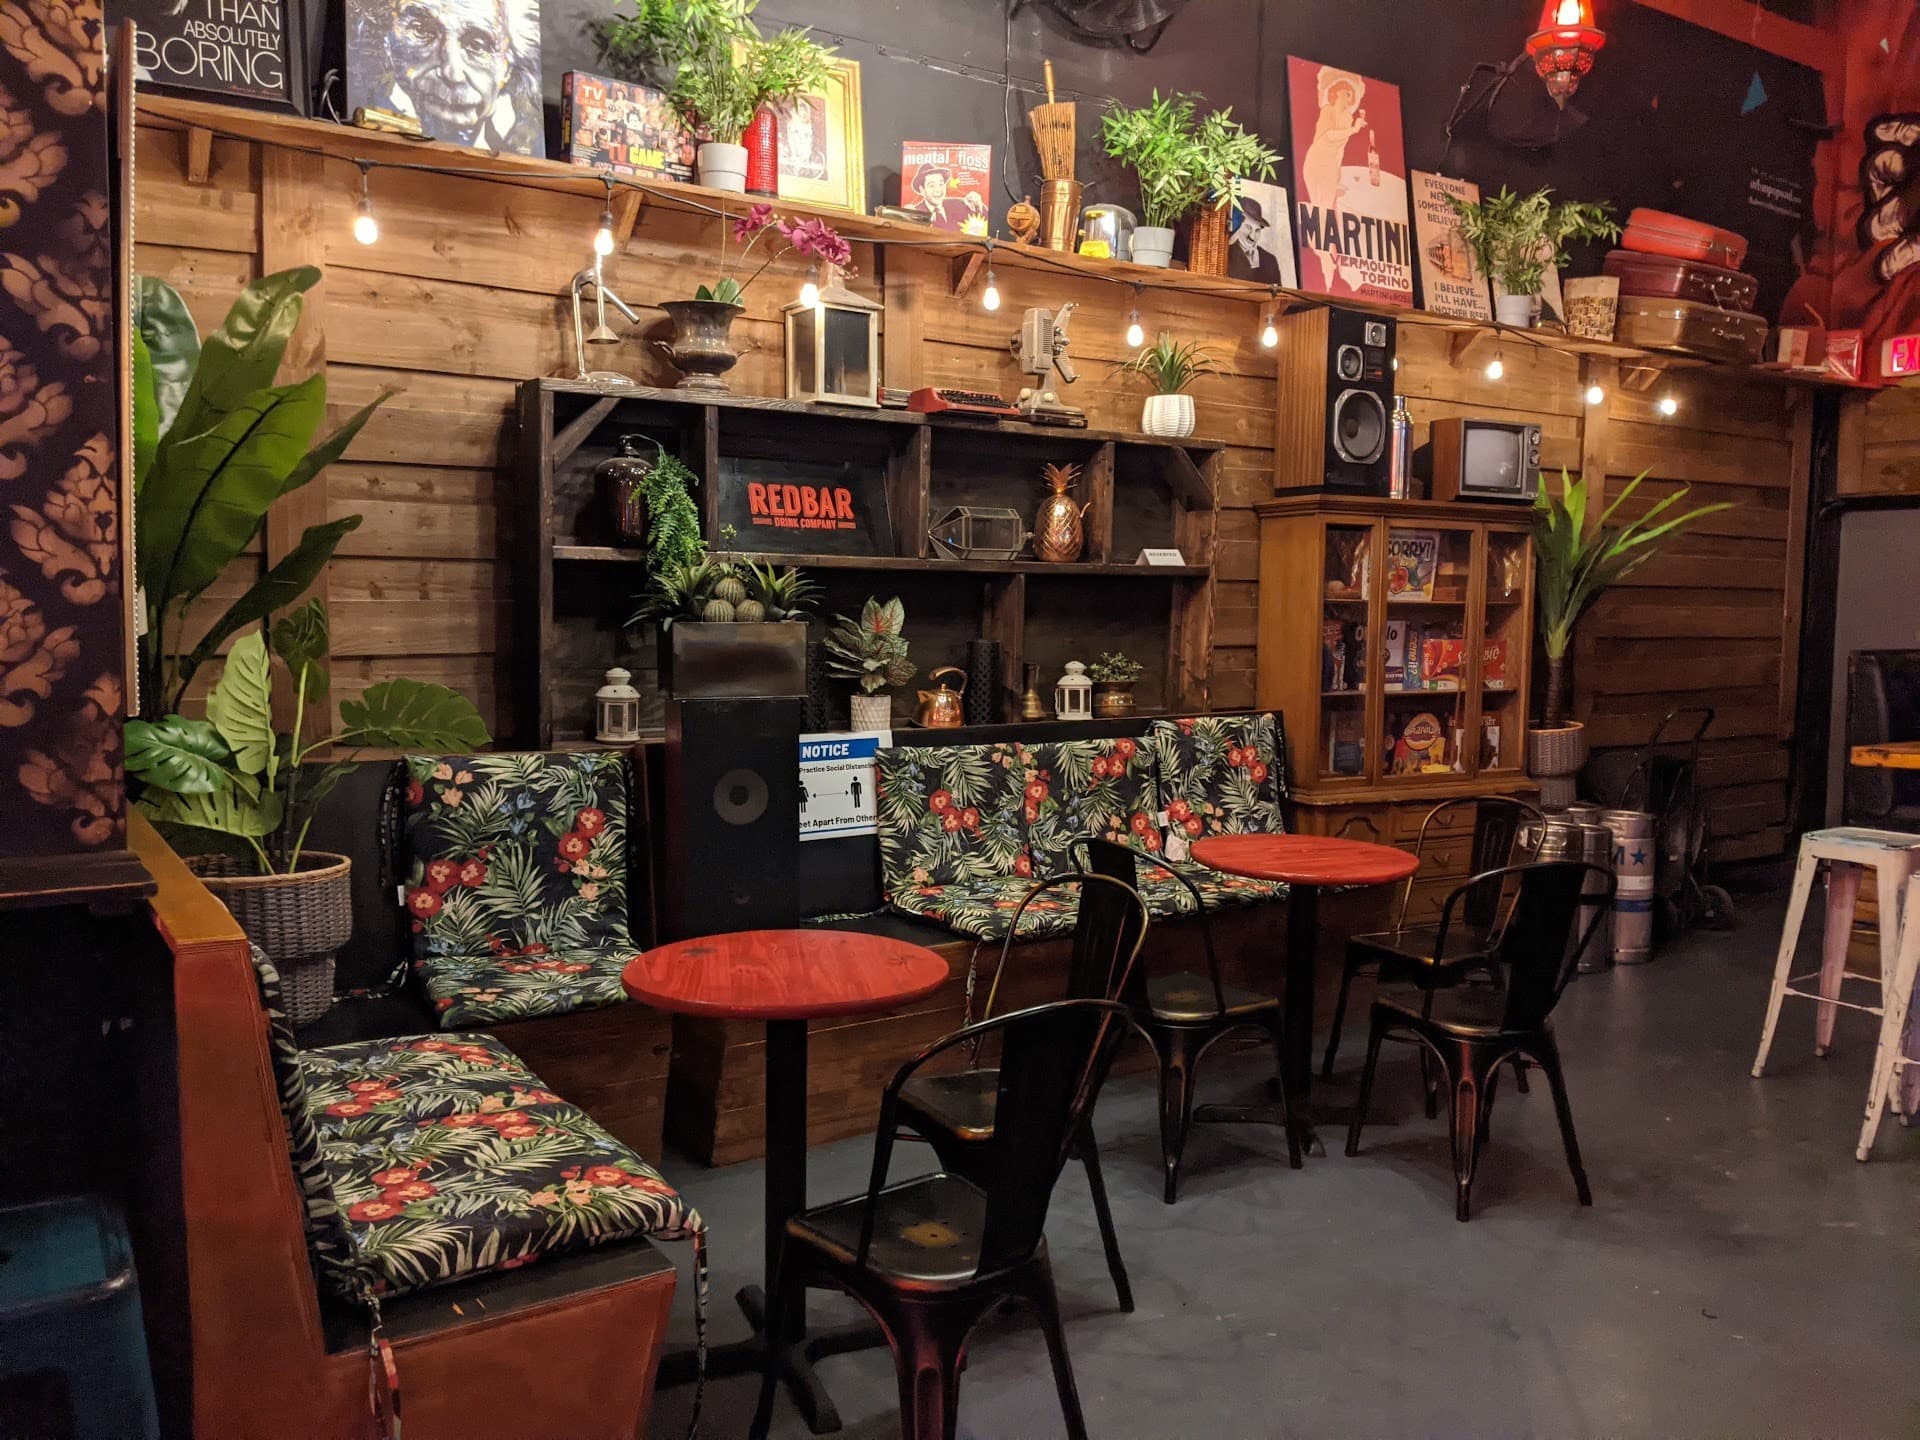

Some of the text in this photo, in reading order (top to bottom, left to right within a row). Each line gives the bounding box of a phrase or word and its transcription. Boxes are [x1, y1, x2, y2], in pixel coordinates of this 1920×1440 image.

[206, 0, 280, 30] THAN
[184, 19, 280, 50] ABSOLUTELY
[136, 31, 283, 89] BORING
[583, 84, 603, 100] TV
[629, 144, 665, 170] GAME
[1424, 178, 1466, 195] EVERYONE
[1300, 203, 1409, 267] MARTINI
[1330, 252, 1403, 277] VERMOUTH
[1360, 271, 1410, 290] TORINO
[1434, 281, 1438, 291] I
[1429, 304, 1489, 321] ANOTHER BEER
[1893, 337, 1920, 372] EX
[747, 482, 855, 520] REDBAR
[774, 517, 837, 530] DRINK COMPANY
[802, 743, 850, 759] NOTICE
[800, 762, 875, 774] Practice Social Distancin
[799, 813, 876, 829] eet Apart From Other
